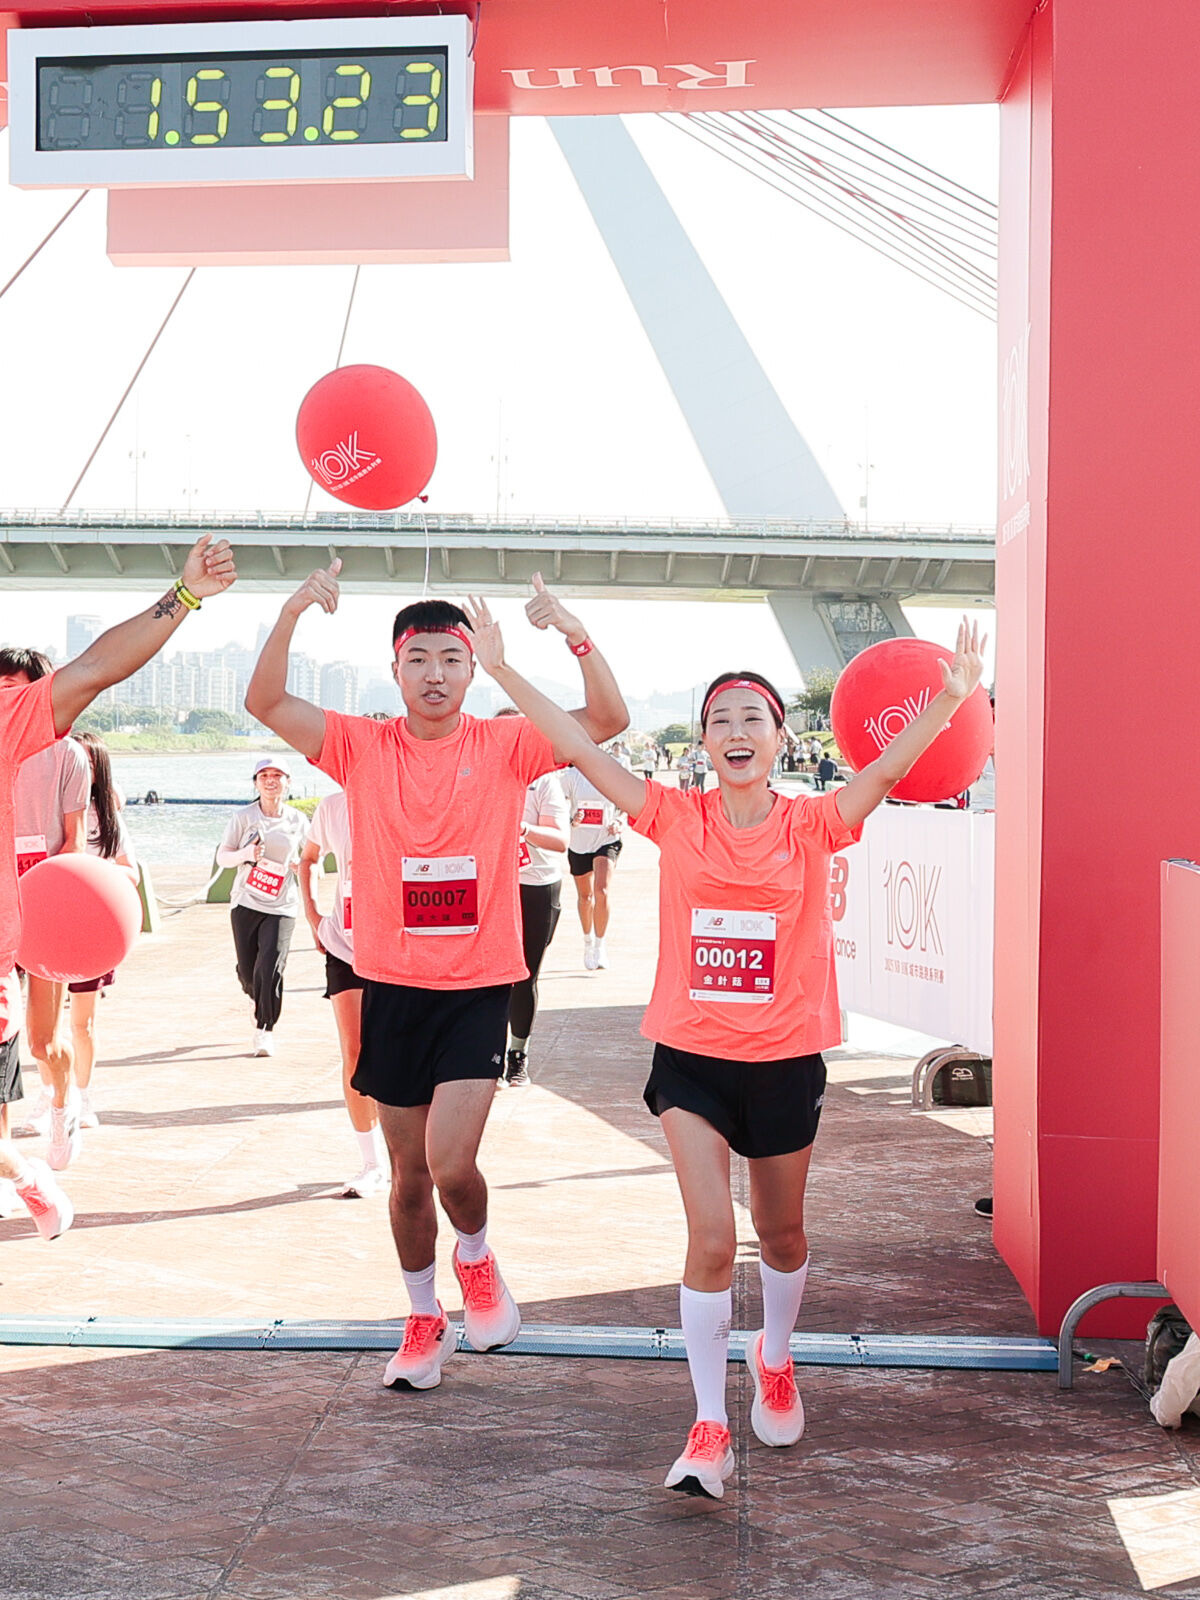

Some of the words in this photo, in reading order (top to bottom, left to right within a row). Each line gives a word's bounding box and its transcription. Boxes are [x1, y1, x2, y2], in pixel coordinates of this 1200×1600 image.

[502, 60, 757, 89] Run
[312, 430, 377, 485] 10K
[408, 889, 467, 907] 00007
[883, 860, 944, 956] 10K
[695, 946, 763, 970] 00012
[835, 938, 857, 960] ance
